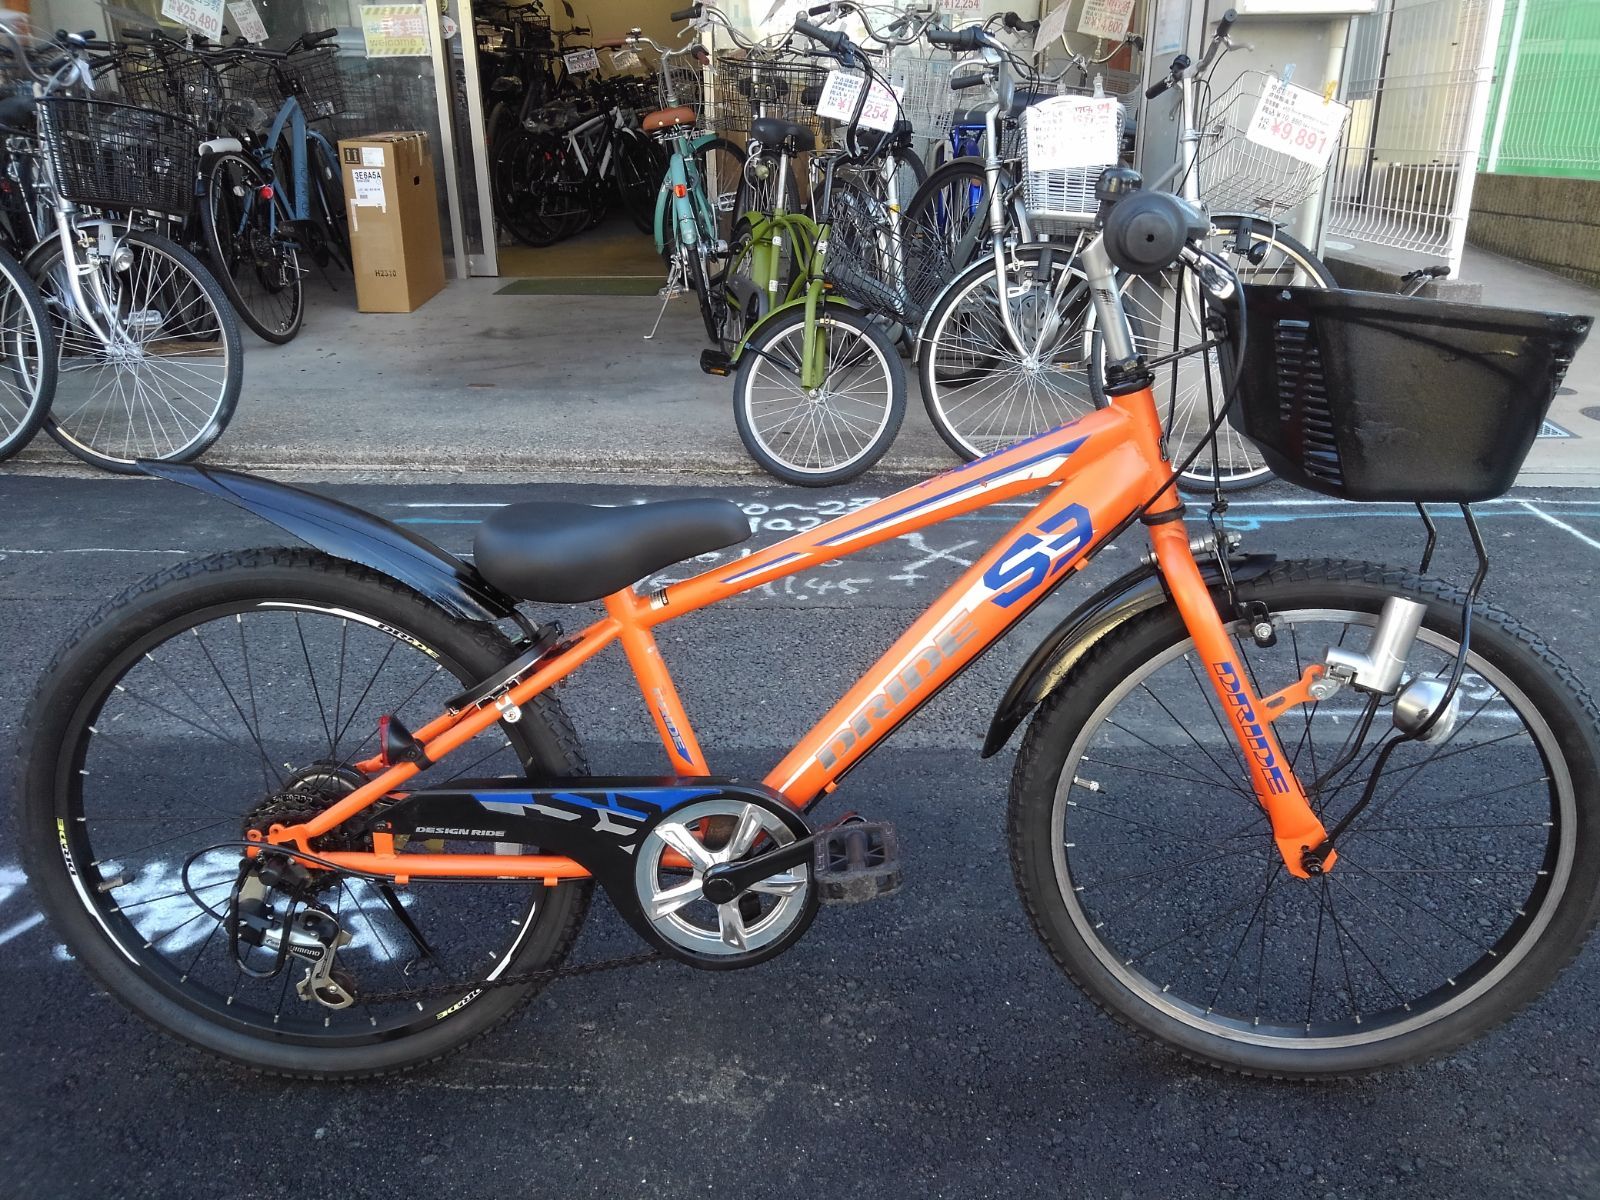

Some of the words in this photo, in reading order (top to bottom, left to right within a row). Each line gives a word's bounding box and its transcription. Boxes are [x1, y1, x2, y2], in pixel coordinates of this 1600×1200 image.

[369, 38, 417, 47] welcome
[1271, 119, 1327, 154] ¥9,891
[815, 608, 980, 770] DRIDE
[1212, 661, 1290, 795] DRIDE
[415, 826, 470, 836] DESIGN
[470, 829, 506, 837] RIDE
